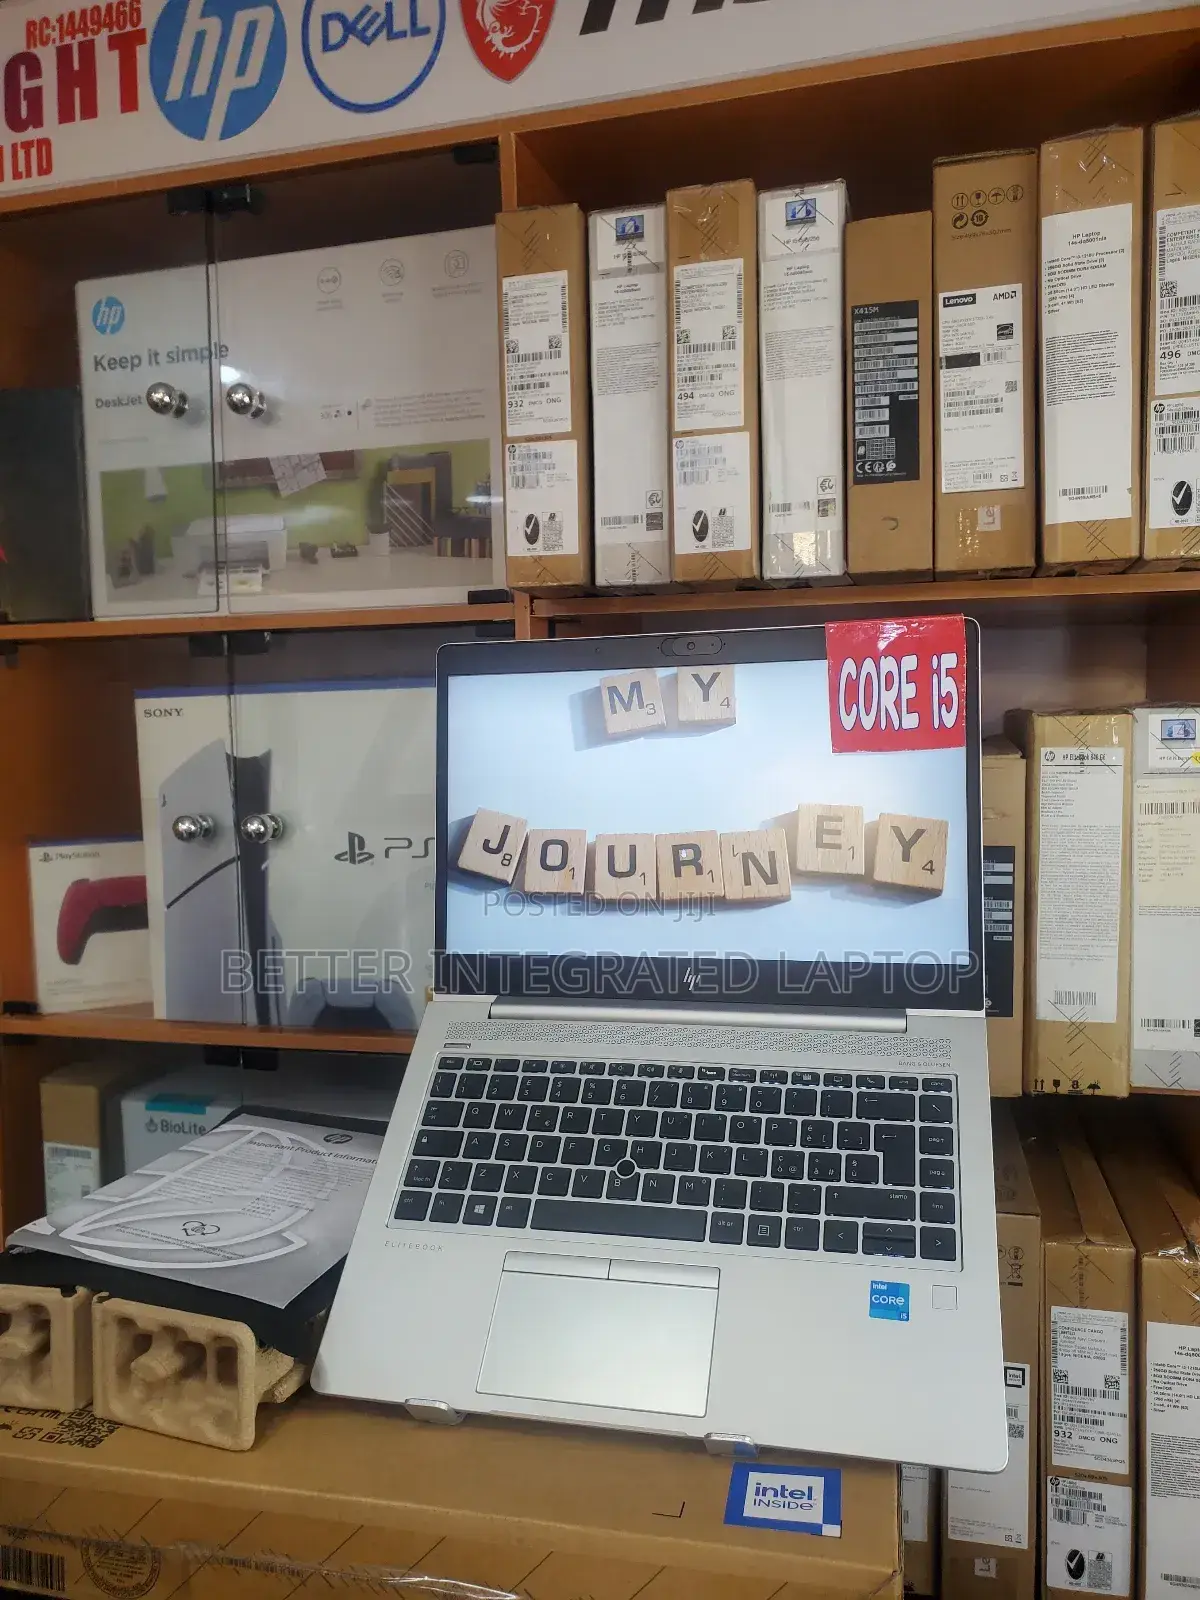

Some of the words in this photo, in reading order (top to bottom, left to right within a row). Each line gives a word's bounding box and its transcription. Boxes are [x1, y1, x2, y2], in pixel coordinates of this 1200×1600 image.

[26, 0, 141, 50] RC:1449466
[321, 0, 431, 53] DELL
[12, 138, 53, 180] LTD
[945, 296, 974, 304] Lenovo
[993, 291, 1010, 301] AMD
[854, 307, 880, 315] X415M
[93, 353, 142, 372] Keep
[147, 348, 160, 366] it
[166, 341, 229, 364] simple
[1160, 350, 1181, 360] 496
[95, 394, 143, 409] DeskJet
[508, 400, 524, 408] 932
[677, 392, 695, 401] 494
[837, 652, 919, 733] CORE
[931, 651, 960, 730] i5
[143, 707, 183, 719] SONY
[55, 851, 101, 862] PlayStation
[160, 1118, 207, 1136] BioLite
[247, 1140, 293, 1152] Important
[295, 1146, 334, 1158] Product
[872, 1282, 887, 1290] intel
[1054, 1429, 1073, 1440] 932
[1099, 1436, 1118, 1444] ONG
